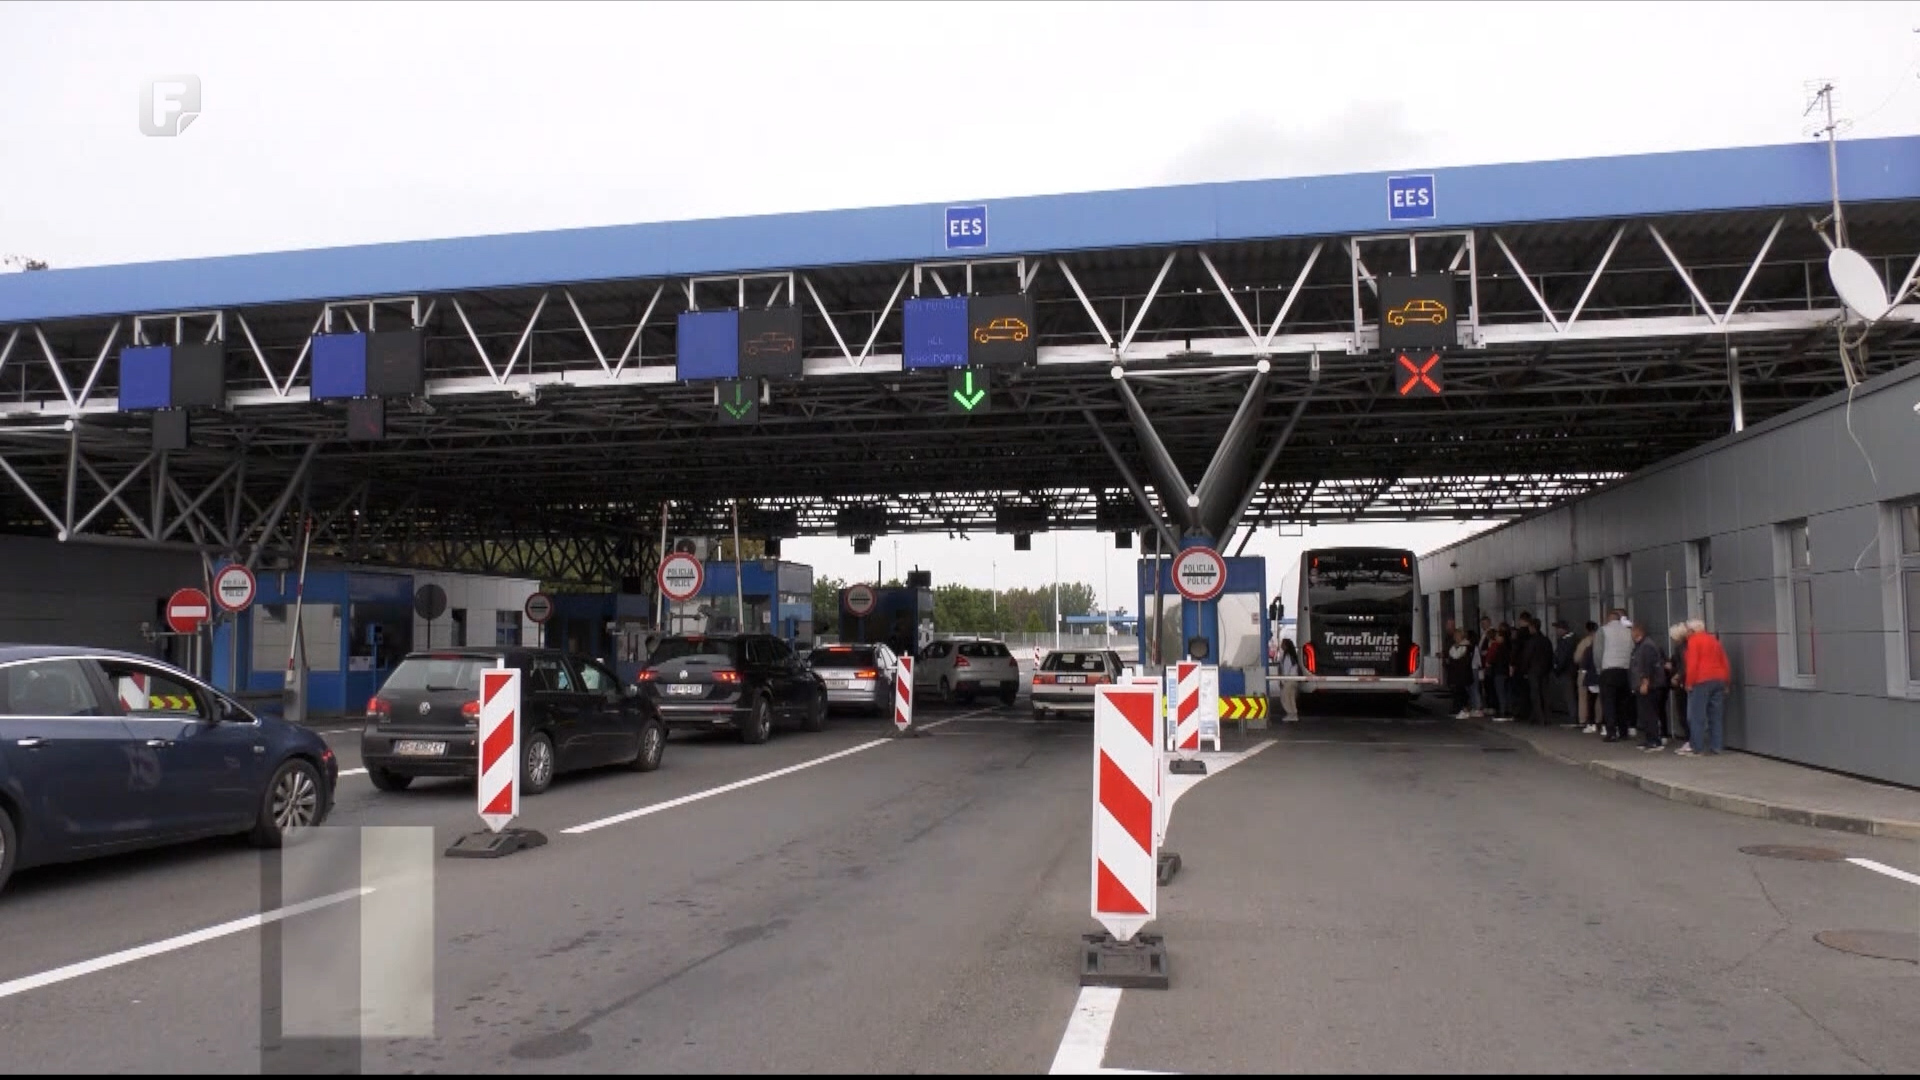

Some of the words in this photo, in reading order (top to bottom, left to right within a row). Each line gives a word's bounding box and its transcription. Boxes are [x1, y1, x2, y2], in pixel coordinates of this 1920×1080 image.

[1393, 187, 1430, 208] EES
[950, 217, 982, 238] EES
[1183, 564, 1215, 572] POLICIJA
[1186, 577, 1212, 585] POLICE
[1324, 631, 1399, 646] TransTurist
